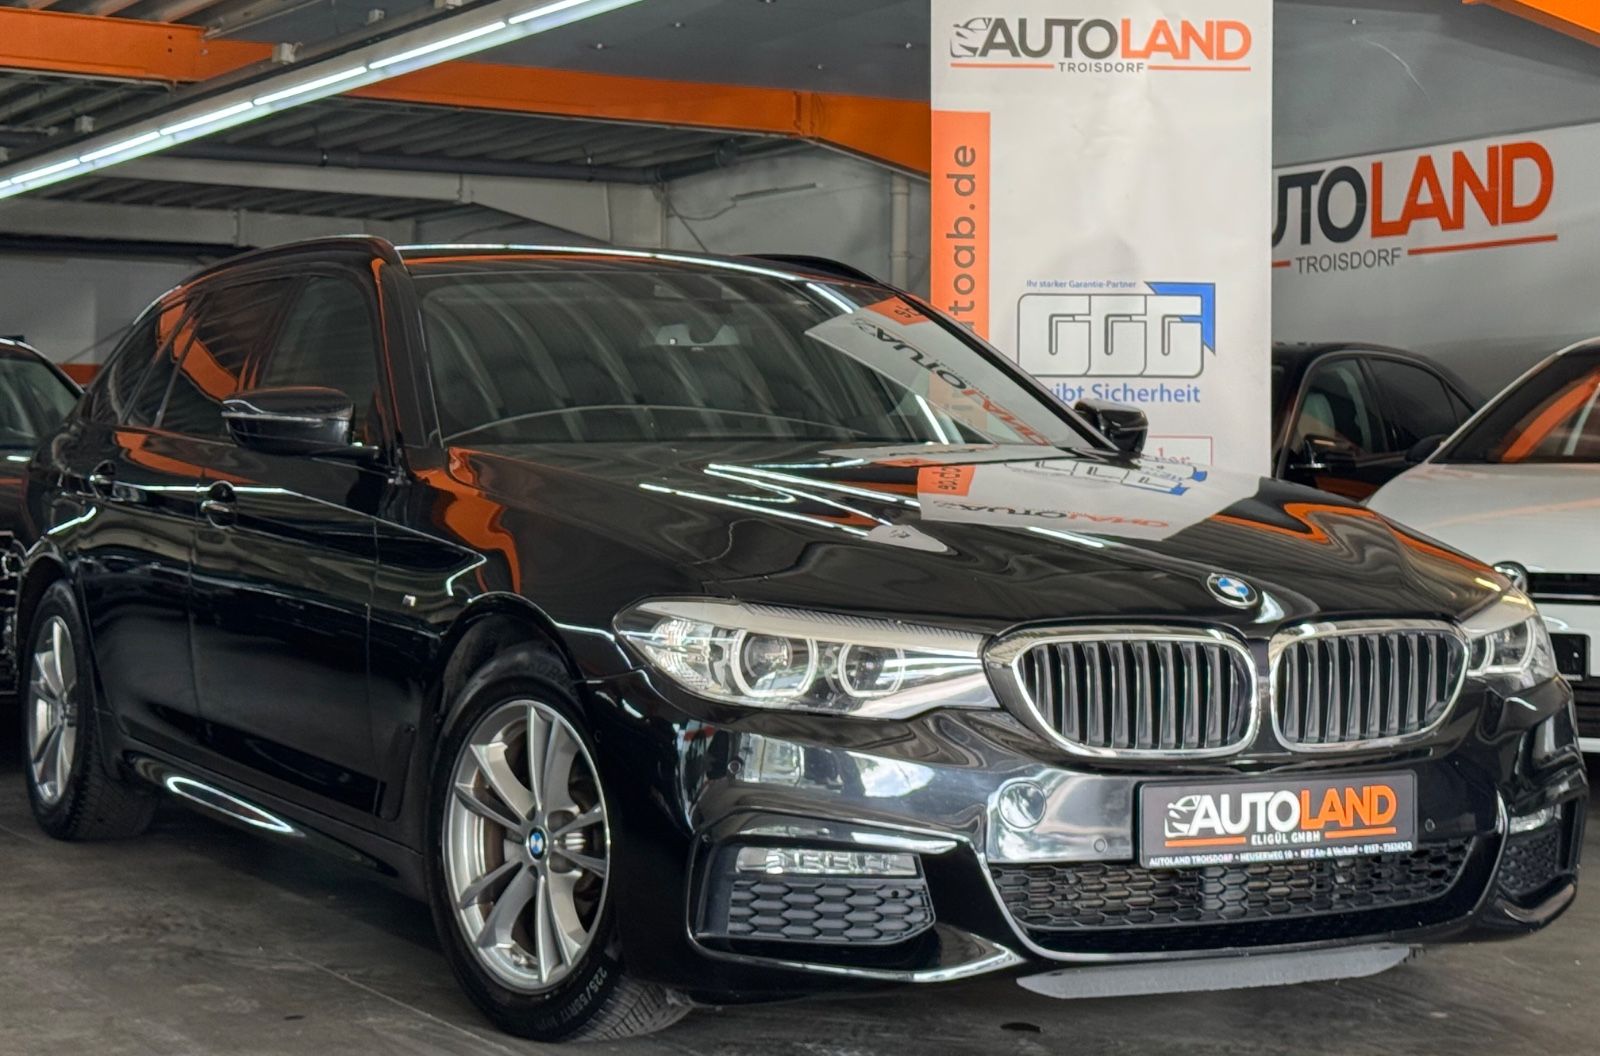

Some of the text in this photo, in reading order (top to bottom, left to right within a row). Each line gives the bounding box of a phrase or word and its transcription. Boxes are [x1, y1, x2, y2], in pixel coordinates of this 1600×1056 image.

[977, 17, 1252, 61] AUTOLAND
[1058, 61, 1145, 73] TROISDORF
[946, 145, 976, 328] toab.de
[1295, 247, 1402, 275] TROISDORF
[1026, 279, 1137, 289] Ihr starker Garantie-Partner
[1052, 382, 1201, 403] ibt Sicherheit
[1187, 784, 1398, 836] AUTOLAND
[1251, 830, 1321, 845] ELIGÜL GMBH
[1149, 855, 1190, 867] AUTOLAND
[1191, 853, 1233, 865] TROISDORF
